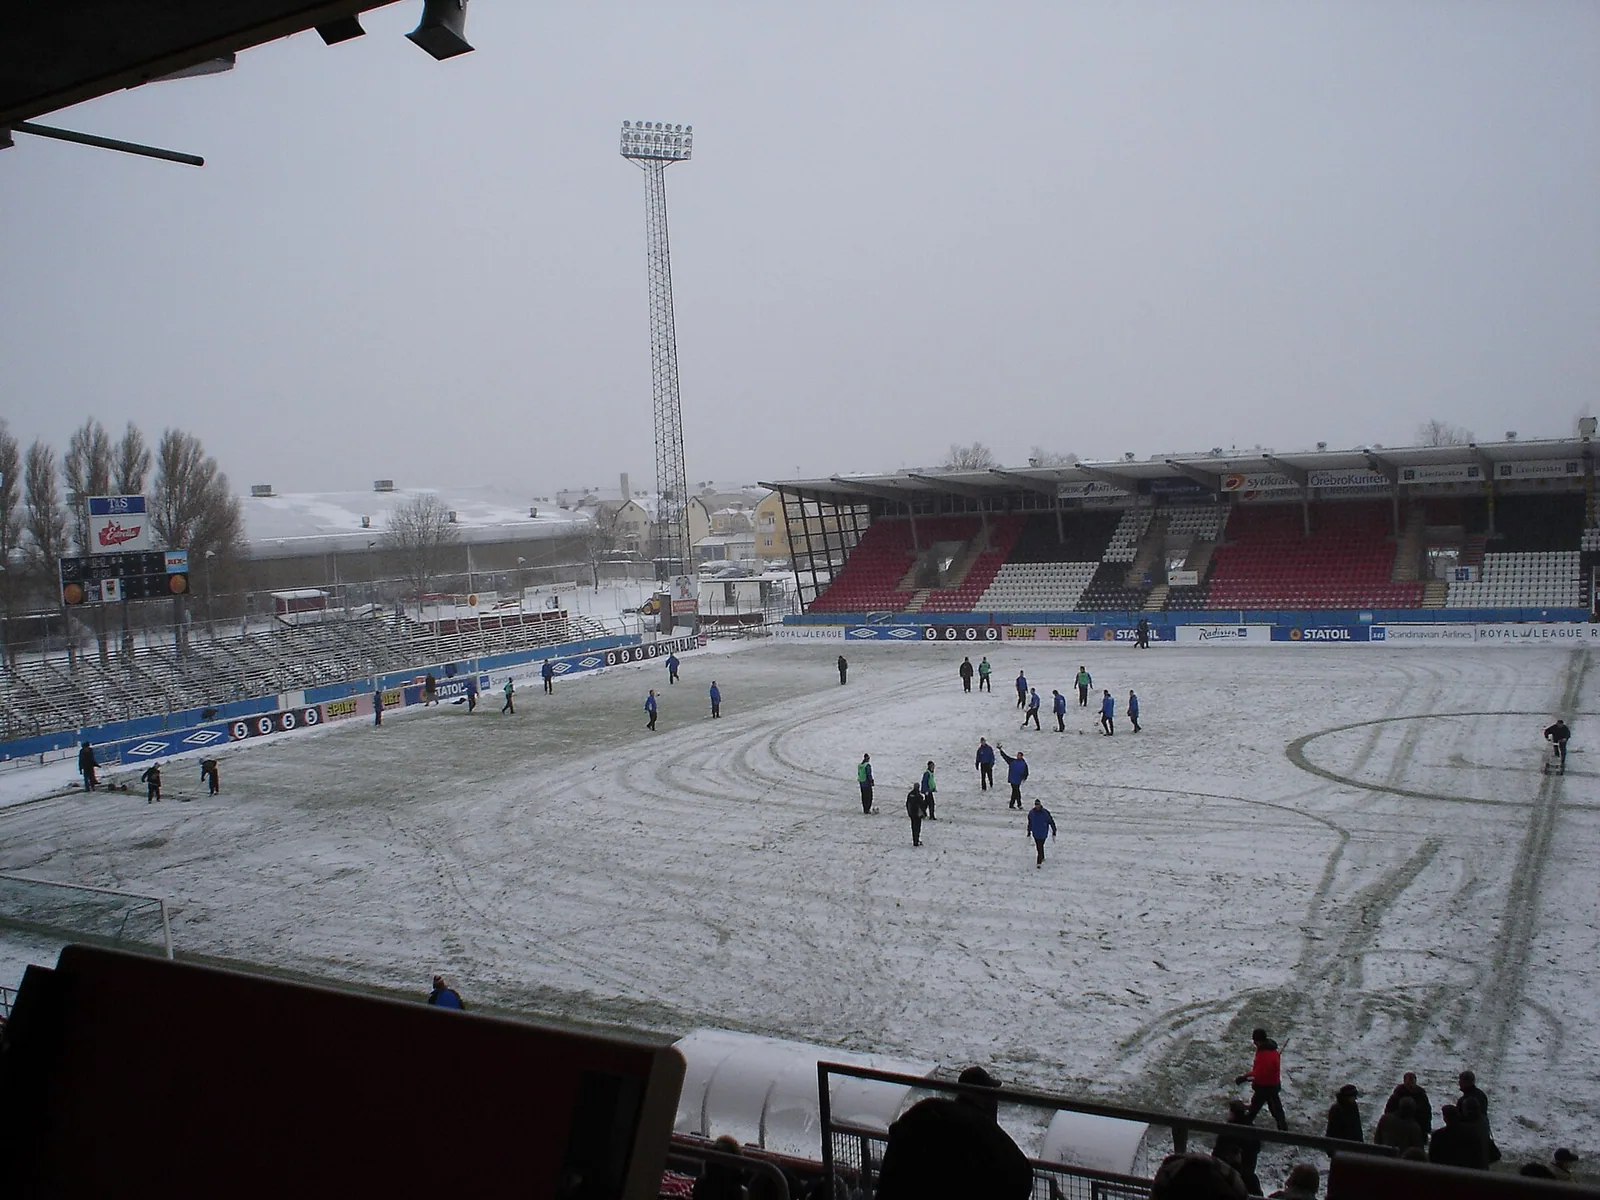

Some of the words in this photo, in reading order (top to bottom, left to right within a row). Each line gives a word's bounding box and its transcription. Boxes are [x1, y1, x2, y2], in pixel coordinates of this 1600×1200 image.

[775, 630, 801, 638] ROYAL
[811, 630, 842, 638] LEAGUE
[1007, 628, 1036, 638] SPORT
[1049, 628, 1079, 638] SPORT
[1116, 629, 1160, 639] STATIL
[1304, 629, 1351, 639] STATOIL
[1388, 630, 1439, 639] Scandinavian
[1442, 630, 1472, 639] Airlines
[1480, 629, 1518, 638] ROYAL
[1533, 629, 1582, 638] LEAGUE
[327, 700, 357, 717] SPORT
